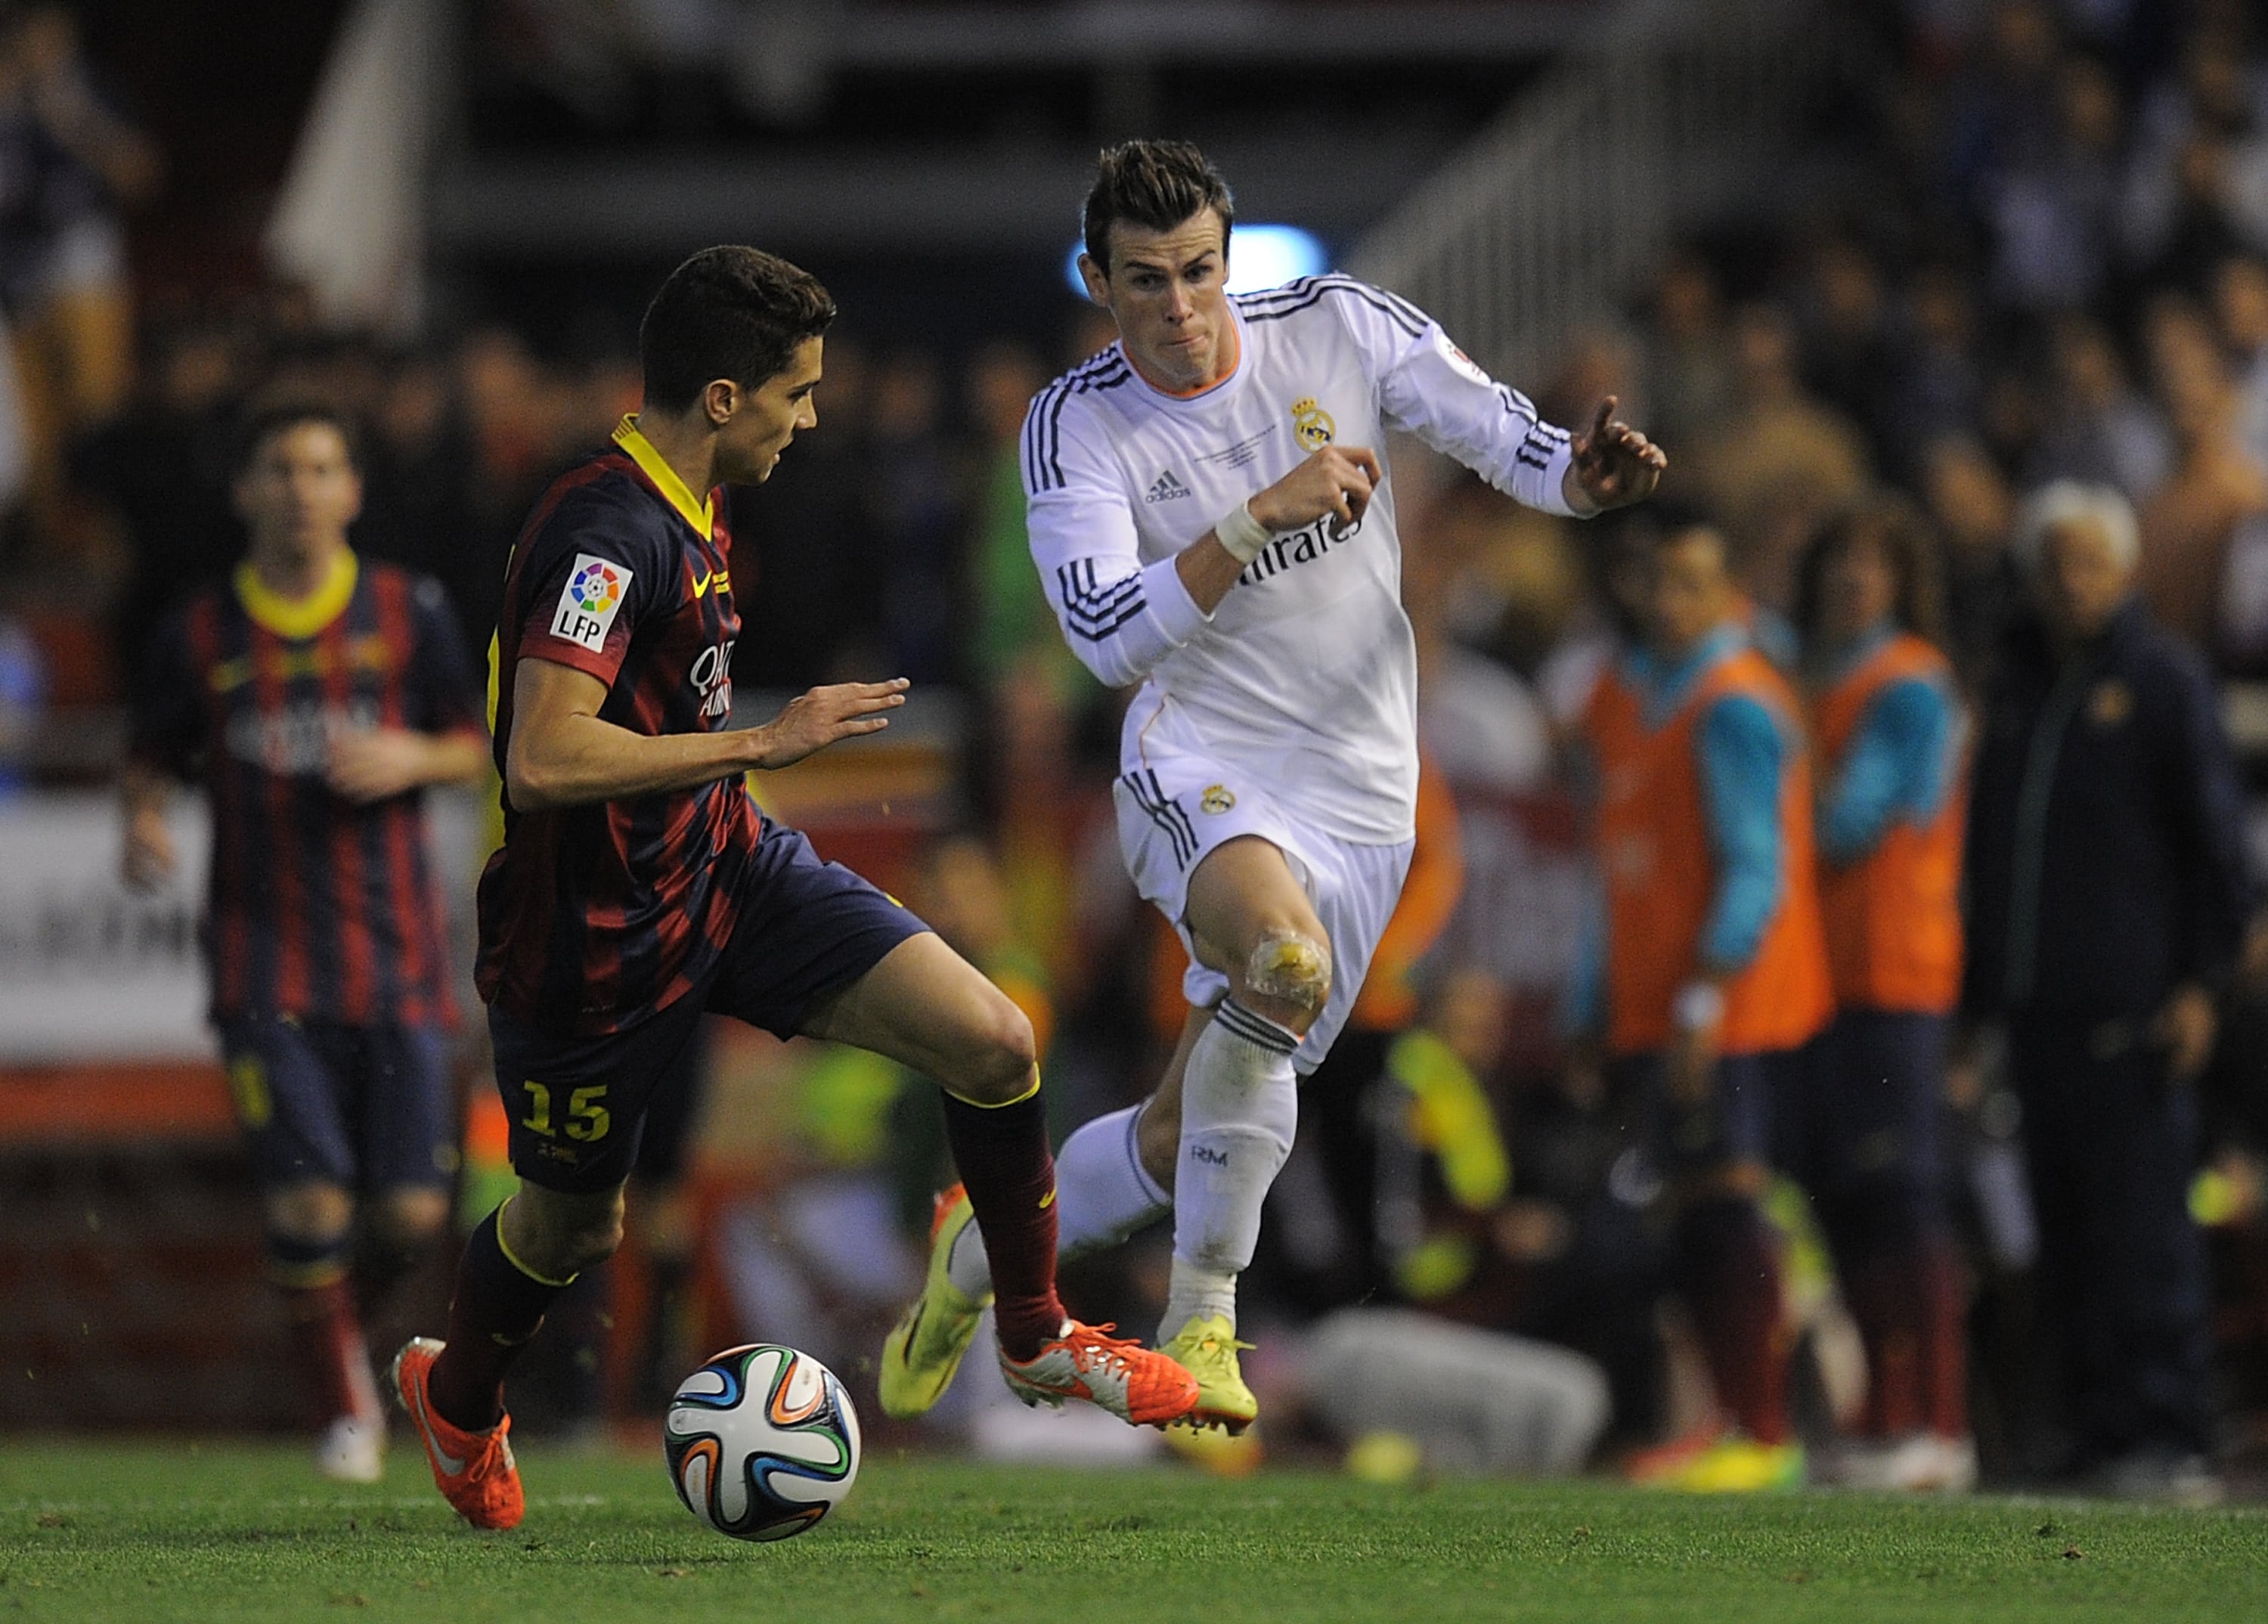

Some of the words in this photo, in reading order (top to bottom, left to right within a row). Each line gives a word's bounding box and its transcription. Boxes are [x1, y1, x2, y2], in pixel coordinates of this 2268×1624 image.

[1145, 487, 1191, 504] adidas
[558, 609, 601, 643] LFP
[522, 1080, 610, 1142] 15
[1191, 1145, 1228, 1167] RM
